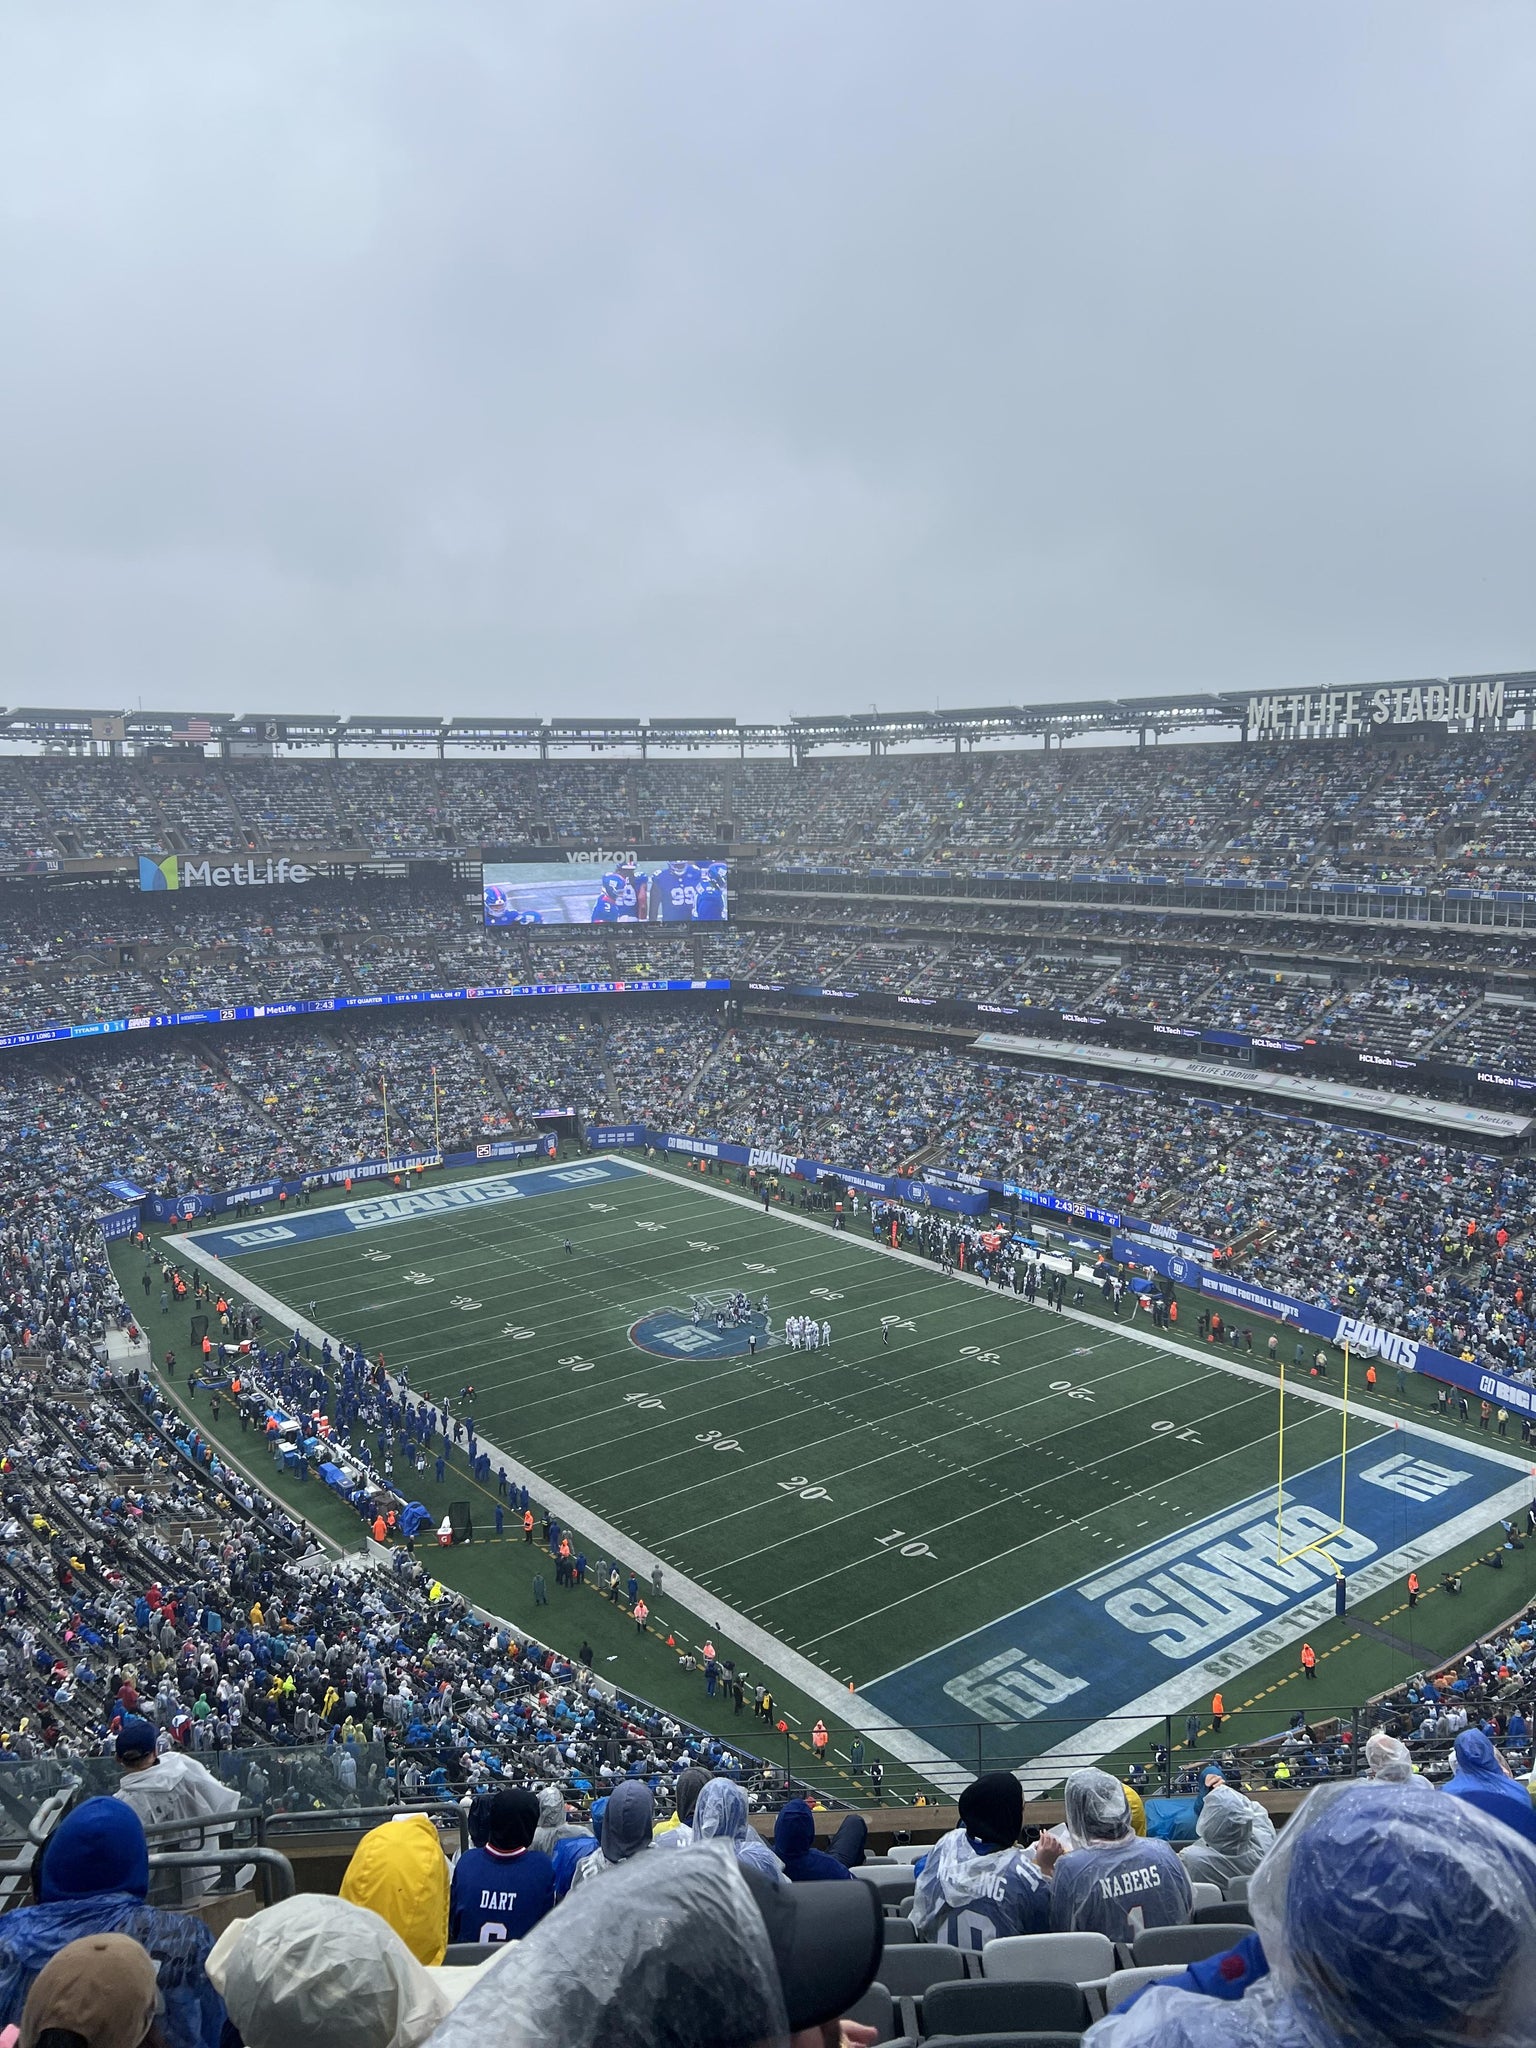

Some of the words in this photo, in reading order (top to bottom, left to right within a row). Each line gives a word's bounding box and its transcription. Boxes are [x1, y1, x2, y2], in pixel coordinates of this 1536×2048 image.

[1248, 691, 1363, 729] METLIFE
[1372, 681, 1505, 724] STADIUM
[566, 848, 638, 864] verizon
[184, 857, 308, 887] MetLife
[222, 1010, 234, 1019] 25
[266, 1005, 296, 1015] MetLife
[315, 1002, 333, 1010] 2:43
[977, 1004, 1001, 1013] HCLTech
[155, 1017, 163, 1026] 3
[1062, 1014, 1088, 1023] HCLTech
[74, 1026, 99, 1035] TITANS
[103, 1024, 110, 1032] 0
[1153, 1025, 1181, 1036] HCLTech
[1251, 1038, 1282, 1050] HCLTech
[1359, 1053, 1392, 1066] HCLTech
[1186, 1063, 1219, 1076] METLIFE
[1220, 1068, 1258, 1081] STADIUM
[1477, 1072, 1514, 1086] HCLTech
[1477, 1114, 1514, 1127] MetLife
[749, 1148, 797, 1175] GIANTS
[331, 1169, 356, 1184] YORK
[357, 1159, 405, 1178] FOOTBALL
[842, 1174, 865, 1187] FOOTBALL
[866, 1180, 885, 1191] GIANTS
[344, 1180, 520, 1224] GIANTS
[1040, 1196, 1047, 1205] 1Q
[1055, 1199, 1072, 1212] 2:43
[1074, 1204, 1085, 1215] 25
[1150, 1223, 1178, 1241] GIANTS
[361, 1249, 392, 1262] 10
[403, 1272, 435, 1285] 20
[450, 1297, 483, 1311] 30
[1202, 1277, 1219, 1291] NEW
[1218, 1282, 1238, 1297] YORK
[1238, 1288, 1273, 1308] FOOTBALL
[1273, 1299, 1299, 1318] GIANTS
[501, 1325, 536, 1340] 40
[1336, 1315, 1420, 1370] GIANTS
[557, 1355, 595, 1372] 50
[959, 1346, 1000, 1364] 30
[1049, 1381, 1095, 1400] 20
[1479, 1375, 1496, 1395] GO
[623, 1391, 663, 1409] 40
[1151, 1420, 1202, 1442] 10
[695, 1430, 740, 1451] 30
[776, 1476, 828, 1500] 20
[441, 1535, 448, 1543] G
[874, 1528, 930, 1557] 10
[1404, 1546, 1431, 1564] IT
[1104, 1505, 1378, 1659] GIANTS
[1279, 1600, 1335, 1630] ALL
[1248, 1630, 1285, 1655] OF
[1204, 1652, 1252, 1678] US
[1099, 1865, 1161, 1899] NABERS
[479, 1890, 517, 1912] DART
